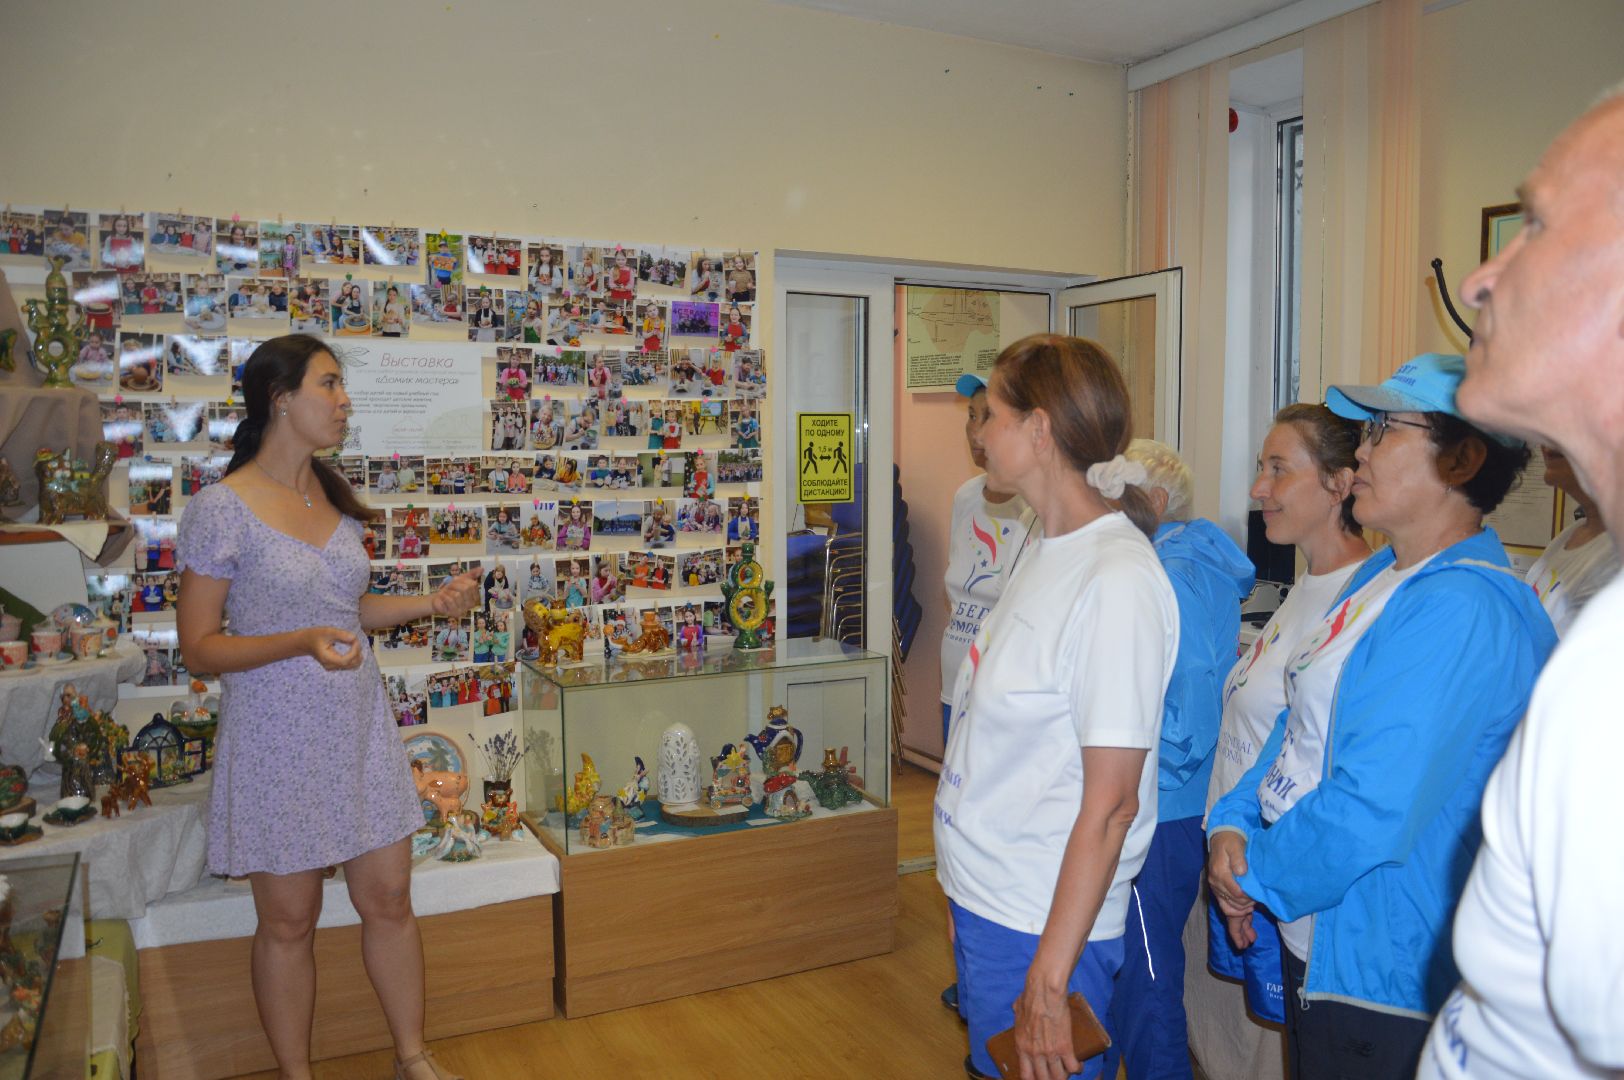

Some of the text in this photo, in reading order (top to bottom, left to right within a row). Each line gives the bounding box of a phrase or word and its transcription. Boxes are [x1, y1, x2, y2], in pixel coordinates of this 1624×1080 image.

[380, 352, 454, 368] Выставка
[811, 419, 838, 427] ХОДИТЕ
[805, 429, 845, 437] ПО ОДНОМУ
[802, 477, 848, 487] СОБЛЮДАЙТЕ
[955, 601, 990, 620] БЕГ
